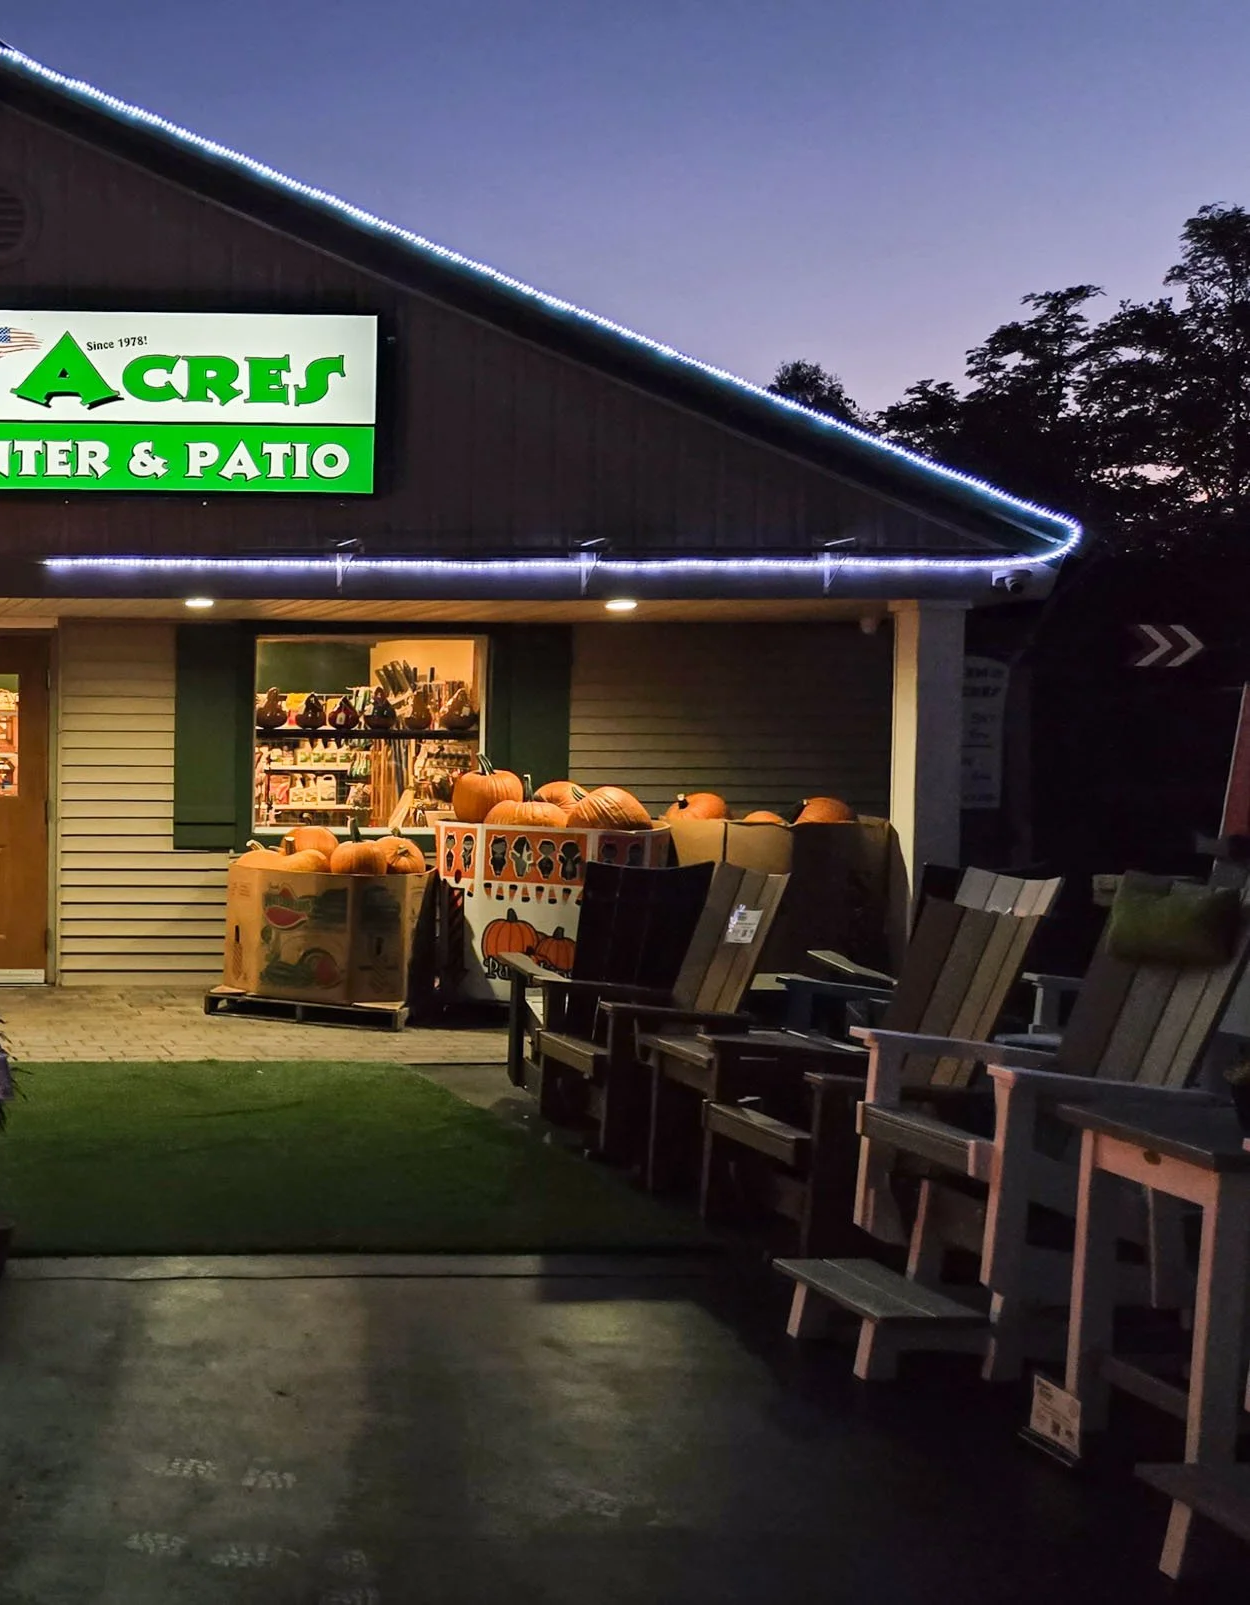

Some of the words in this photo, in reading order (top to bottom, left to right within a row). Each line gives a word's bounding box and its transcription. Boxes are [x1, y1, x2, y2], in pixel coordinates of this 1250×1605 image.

[86, 341, 115, 351] Since
[118, 335, 148, 348] 1978!
[10, 329, 346, 408] ACRES
[128, 440, 170, 479] &
[184, 438, 350, 481] PATIO
